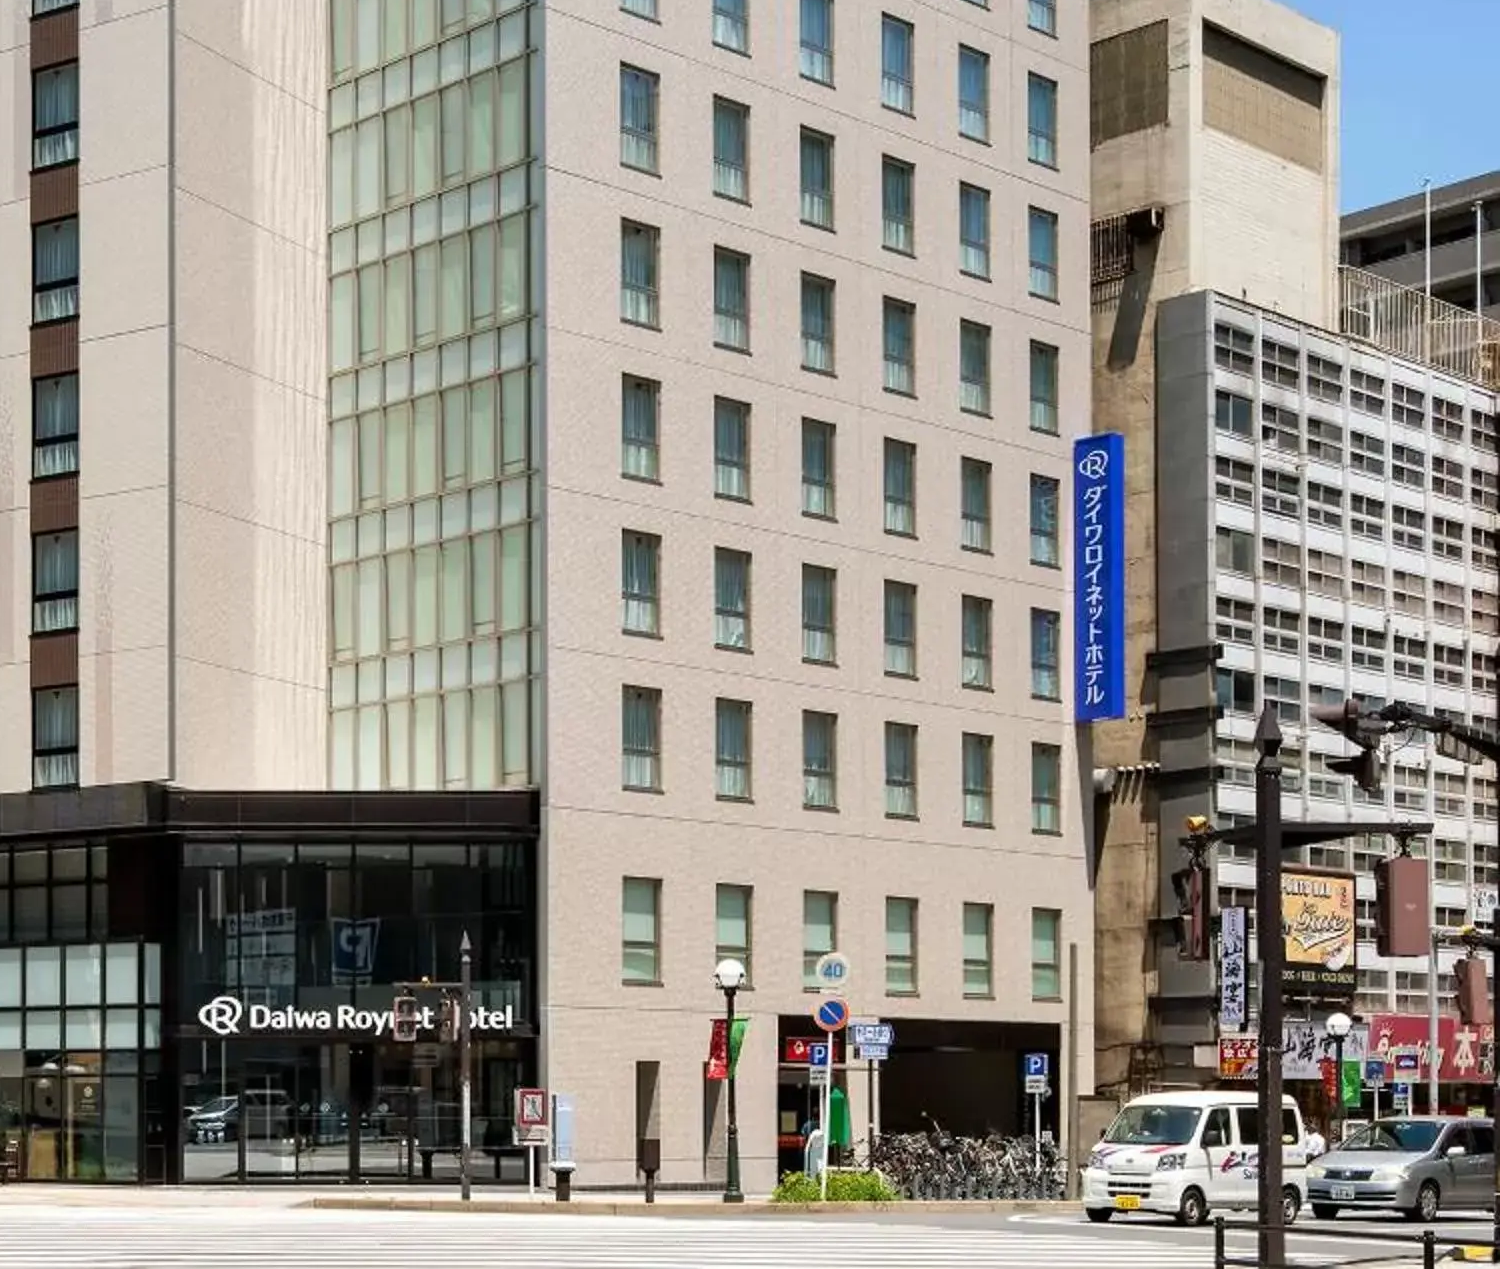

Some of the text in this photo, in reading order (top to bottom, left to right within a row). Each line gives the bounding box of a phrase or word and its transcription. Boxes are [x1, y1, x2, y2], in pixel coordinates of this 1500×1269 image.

[1083, 484, 1108, 705] ダイワロイネットホテル
[823, 962, 843, 978] 40
[250, 1005, 331, 1030] Daiwa
[337, 1005, 435, 1036] Royet
[814, 1046, 825, 1064] P
[1454, 1025, 1477, 1075] 本
[1029, 1056, 1041, 1074] P
